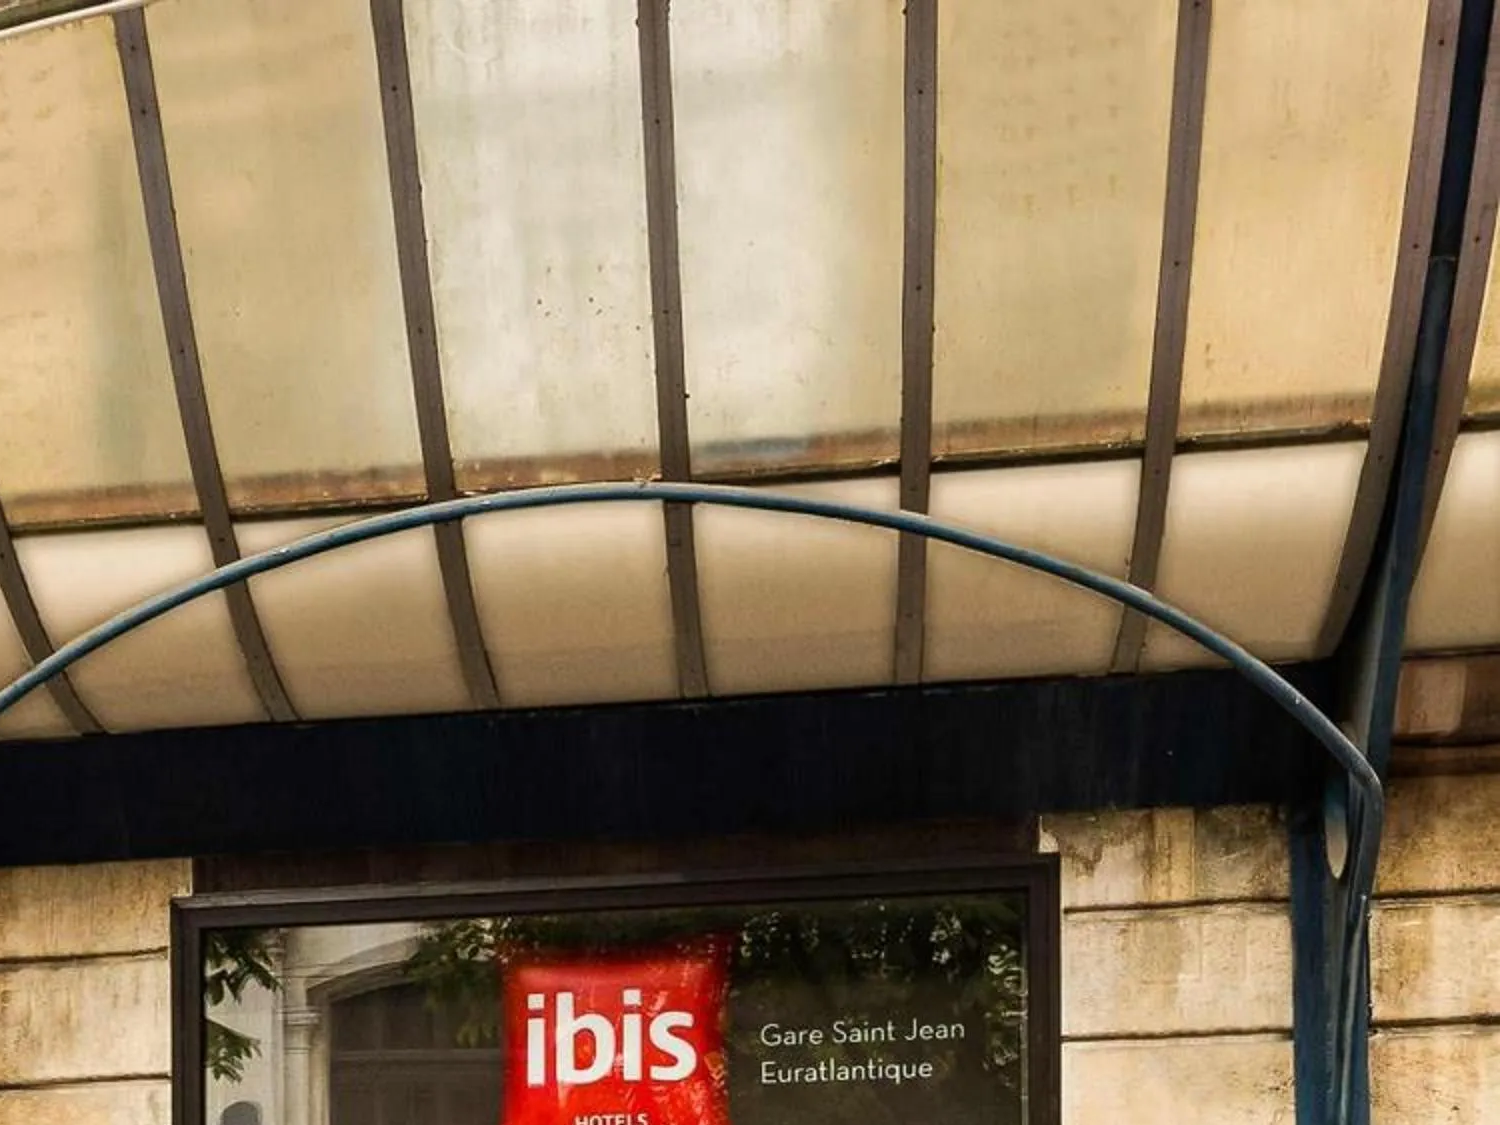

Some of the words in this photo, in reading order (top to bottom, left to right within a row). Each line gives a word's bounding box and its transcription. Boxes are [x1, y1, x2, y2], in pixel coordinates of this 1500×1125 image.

[527, 988, 698, 1088] ibis
[760, 1023, 824, 1047] Gare
[832, 1020, 896, 1044] Saint
[904, 1017, 965, 1041] Jean
[760, 1057, 934, 1085] Euratlantique
